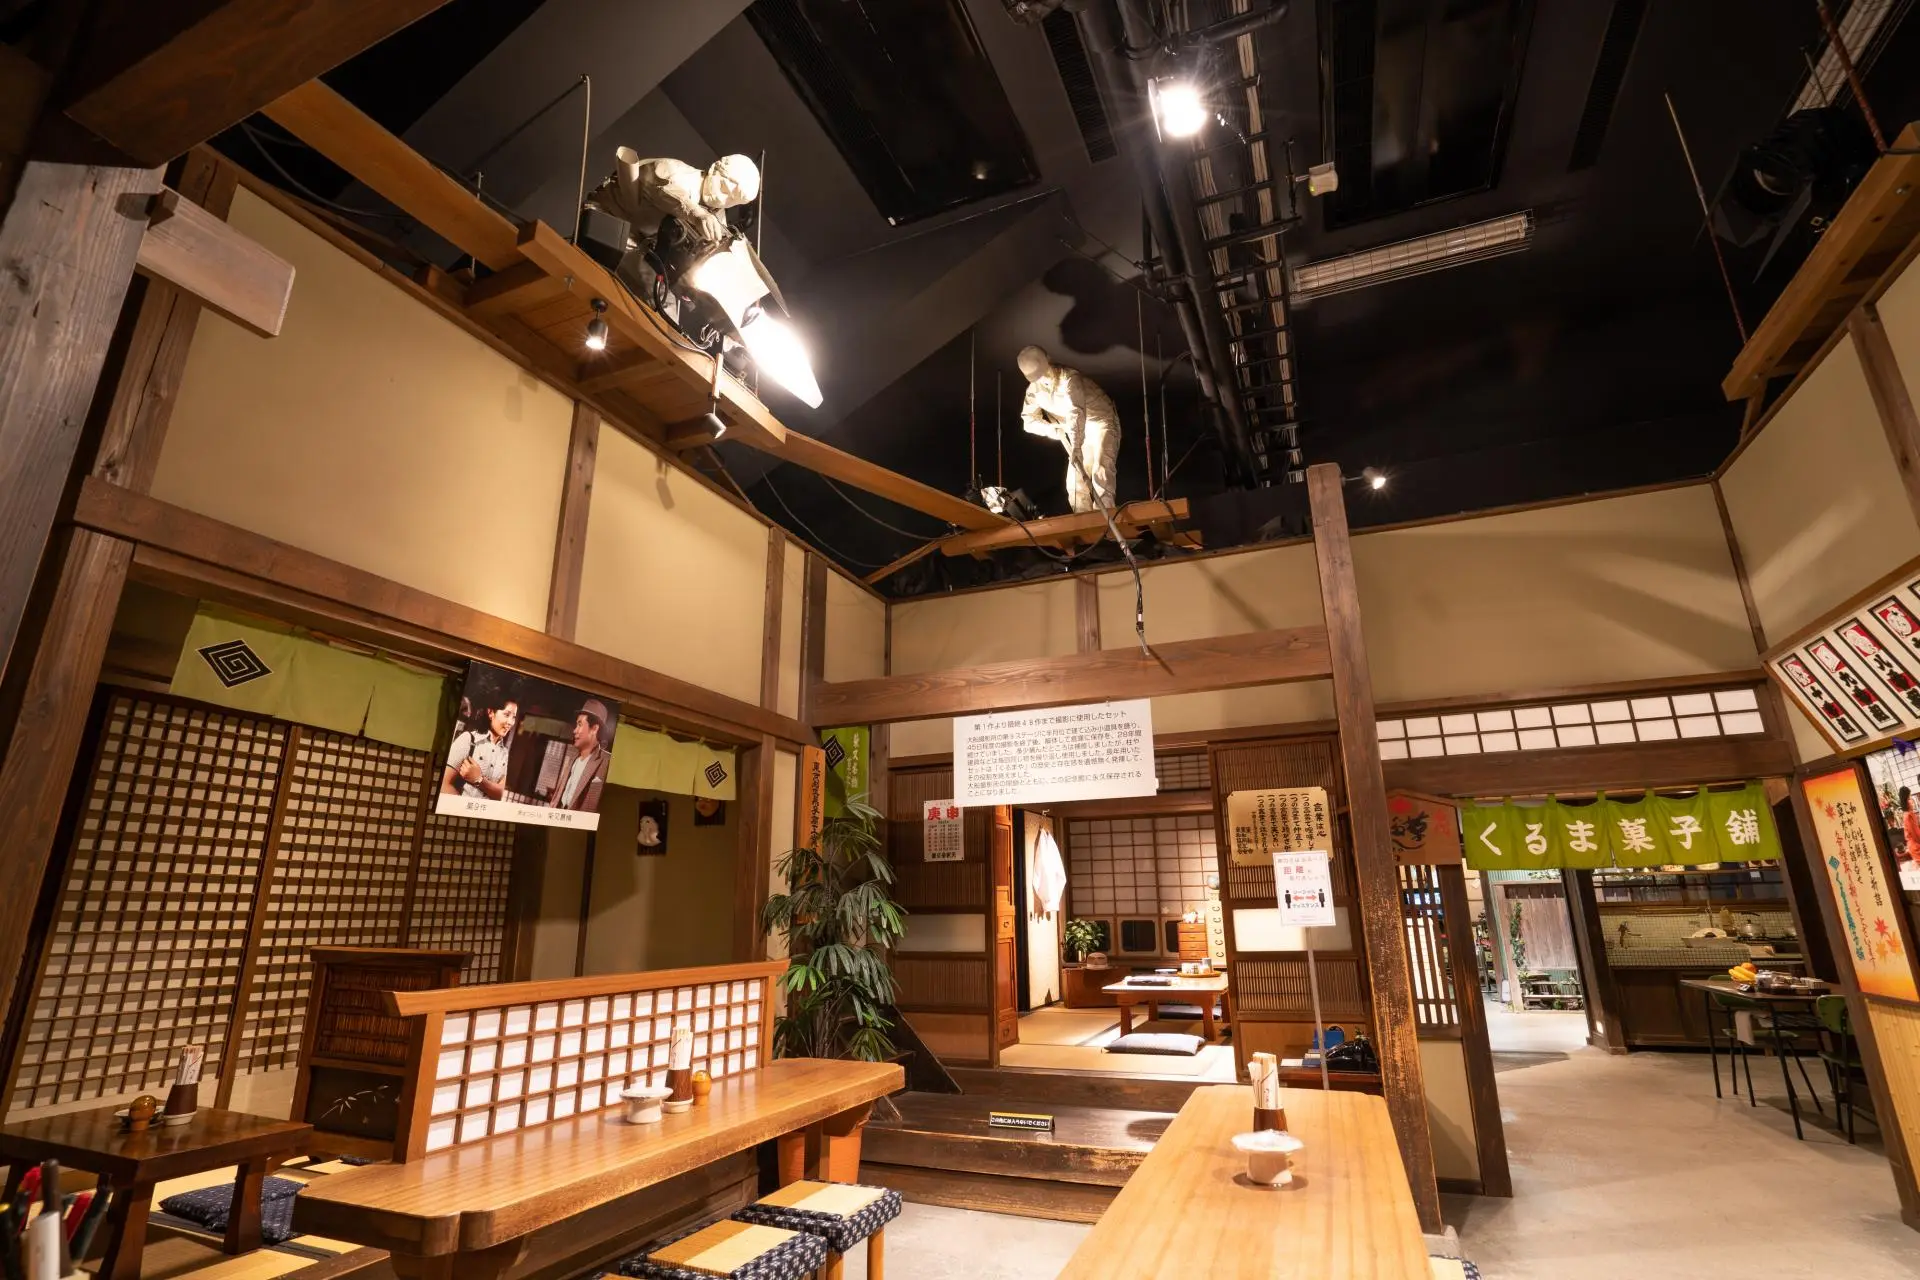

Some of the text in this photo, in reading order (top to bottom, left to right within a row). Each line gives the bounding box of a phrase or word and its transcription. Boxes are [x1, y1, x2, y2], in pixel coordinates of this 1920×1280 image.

[1479, 809, 1761, 856] くるま菓子舗
